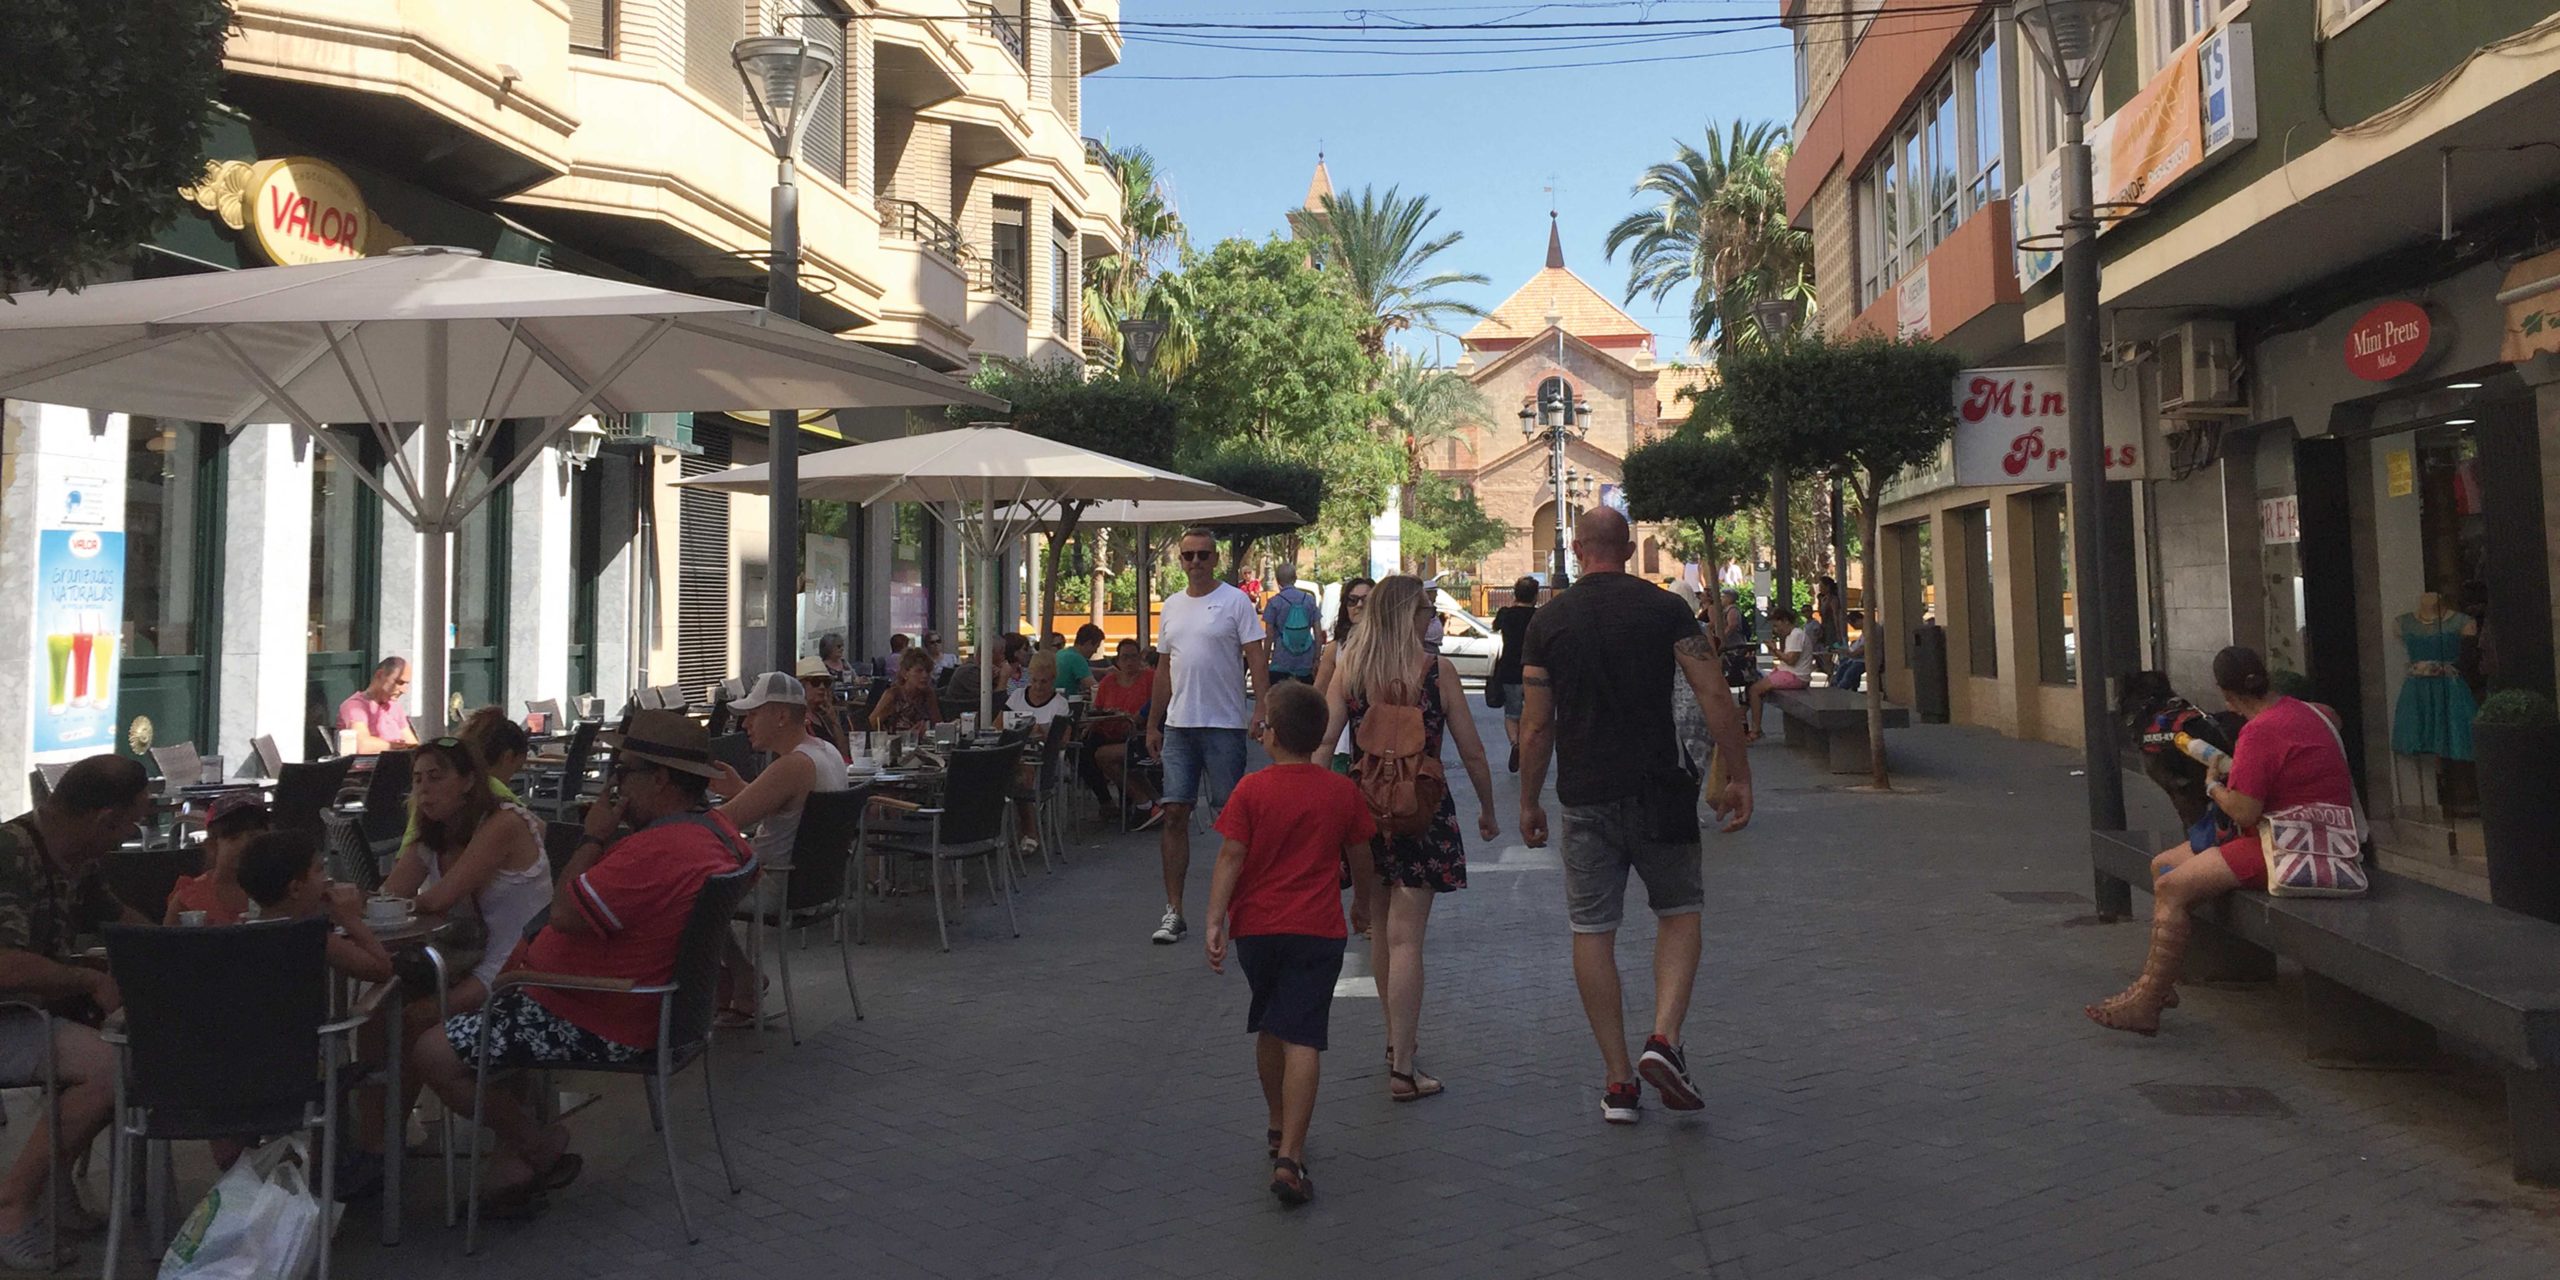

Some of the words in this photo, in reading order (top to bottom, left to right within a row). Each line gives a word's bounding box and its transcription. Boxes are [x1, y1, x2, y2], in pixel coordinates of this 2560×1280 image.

[271, 184, 358, 257] VALOR
[2353, 324, 2382, 358] Mini
[2384, 320, 2420, 348] Preus
[2377, 351, 2396, 369] Moda
[1961, 376, 2067, 424] Min
[2002, 426, 2136, 476] Prus
[71, 538, 99, 551] VALOR
